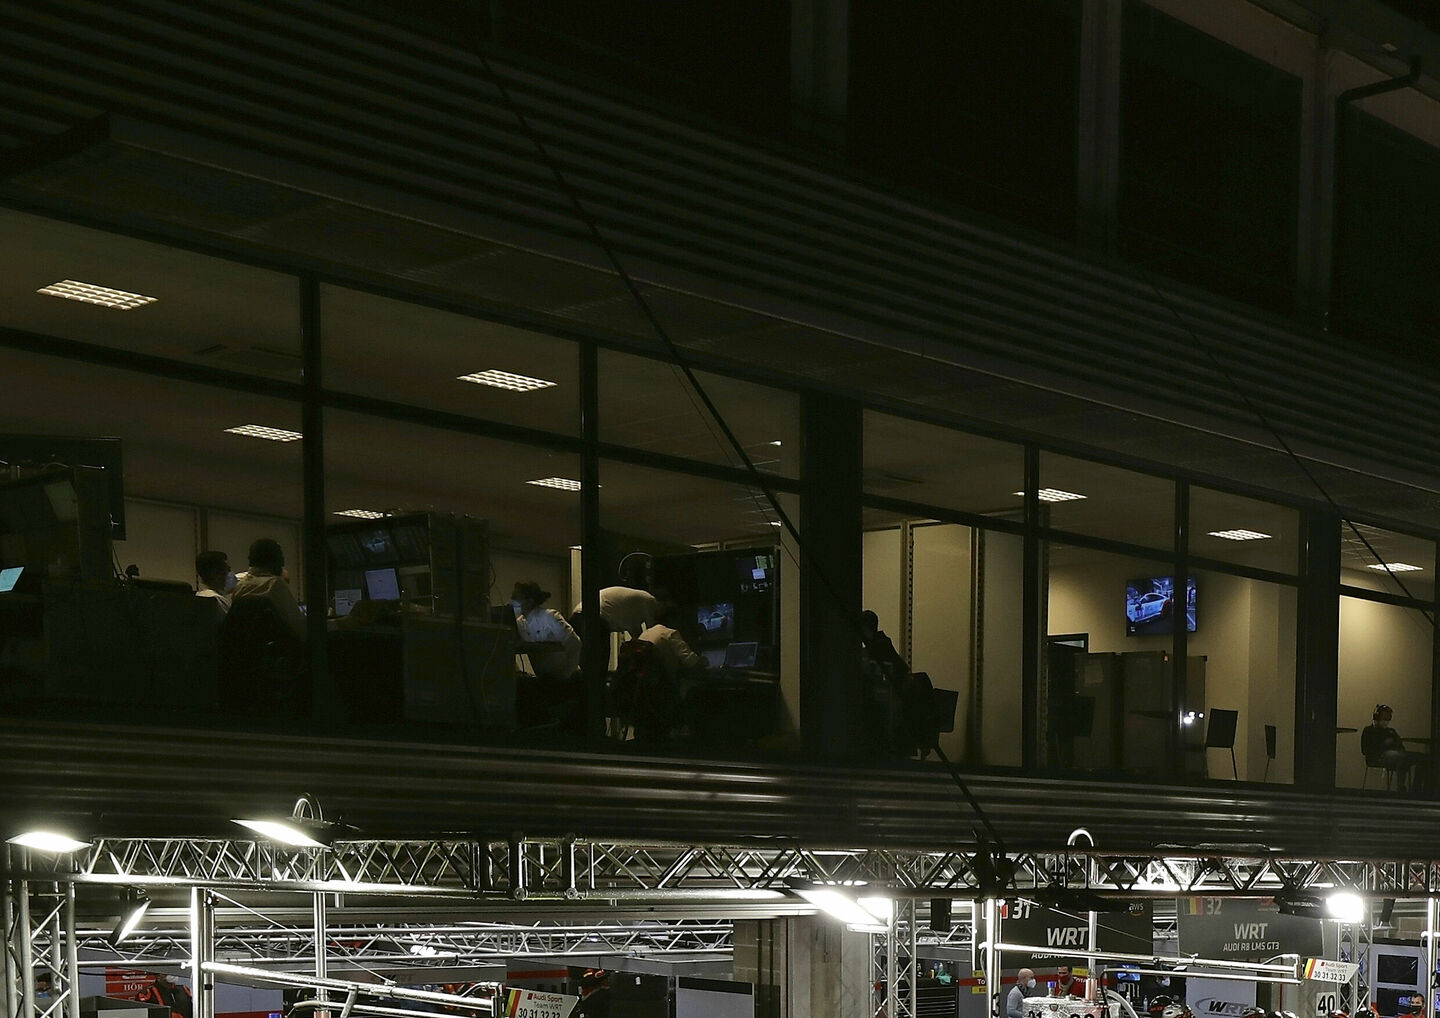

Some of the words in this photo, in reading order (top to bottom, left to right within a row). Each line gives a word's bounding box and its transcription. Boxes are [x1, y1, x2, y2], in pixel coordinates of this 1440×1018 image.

[1012, 899, 1031, 919] 31
[1129, 903, 1144, 912] aws
[1206, 898, 1222, 915] 32
[1046, 926, 1088, 946] WRT
[1234, 923, 1268, 940] WRT
[1223, 943, 1240, 952] AUDI
[1240, 943, 1250, 951] R8
[1251, 942, 1266, 951] LMS
[1267, 941, 1280, 950] GT3
[1322, 971, 1330, 979] 31
[1330, 972, 1338, 980] 32
[1338, 973, 1346, 981] 33
[533, 993, 547, 1001] Audi
[547, 994, 563, 1003] Sport
[1317, 994, 1336, 1014] 40
[533, 1001, 548, 1009] Team
[1208, 1001, 1248, 1015] WRT
[518, 1008, 528, 1018] 30
